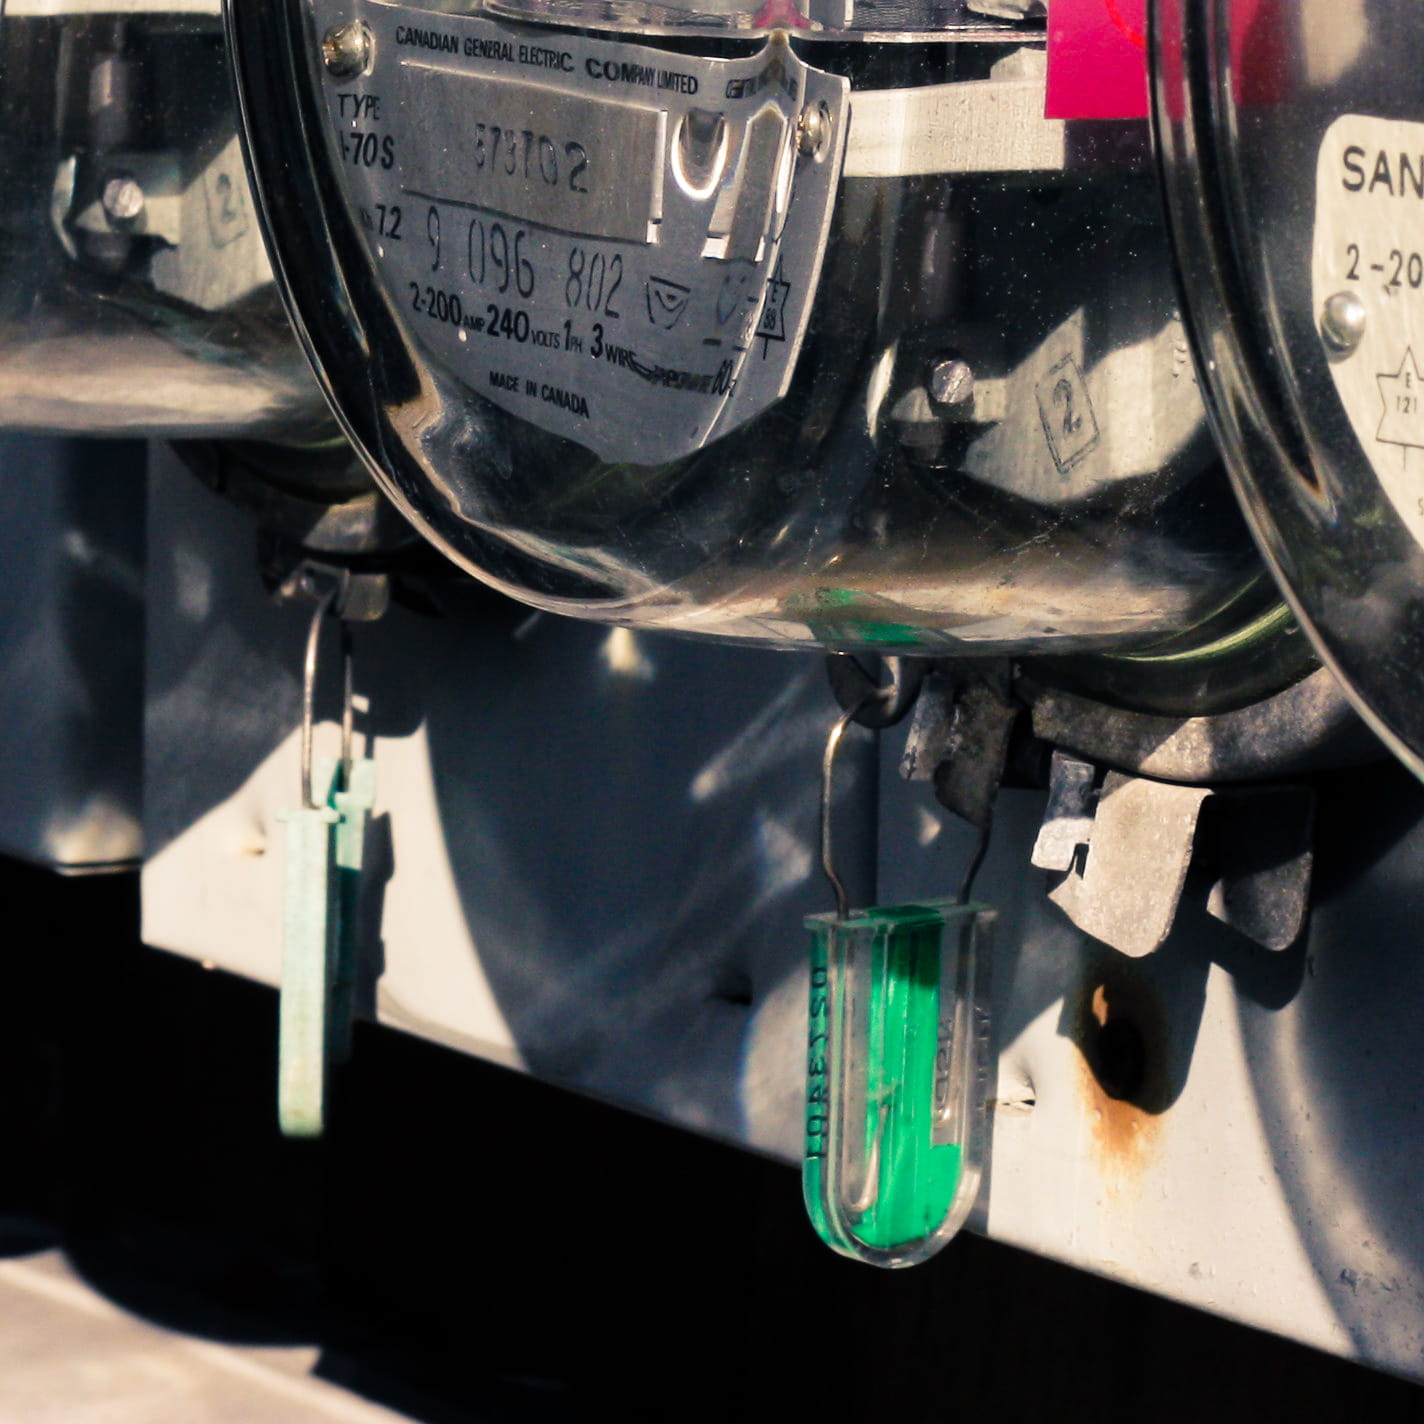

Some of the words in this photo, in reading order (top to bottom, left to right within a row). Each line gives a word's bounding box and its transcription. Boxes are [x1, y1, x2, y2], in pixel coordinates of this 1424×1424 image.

[395, 26, 459, 54] CANADIAN
[464, 37, 515, 62] GENERAL
[519, 45, 574, 73] ELECTRIC
[585, 58, 654, 88] COMPANY
[656, 70, 699, 95] LIMITED
[337, 93, 380, 121] TYPE
[375, 203, 402, 240] 7.2
[467, 218, 535, 299] 096
[564, 246, 623, 319] 802
[409, 281, 462, 327] 2-200
[486, 303, 529, 343] 240
[531, 328, 561, 350] VOLTS
[563, 319, 573, 352] 1
[590, 322, 604, 359] 3
[526, 379, 540, 398] IN
[541, 384, 590, 419] CANADA
